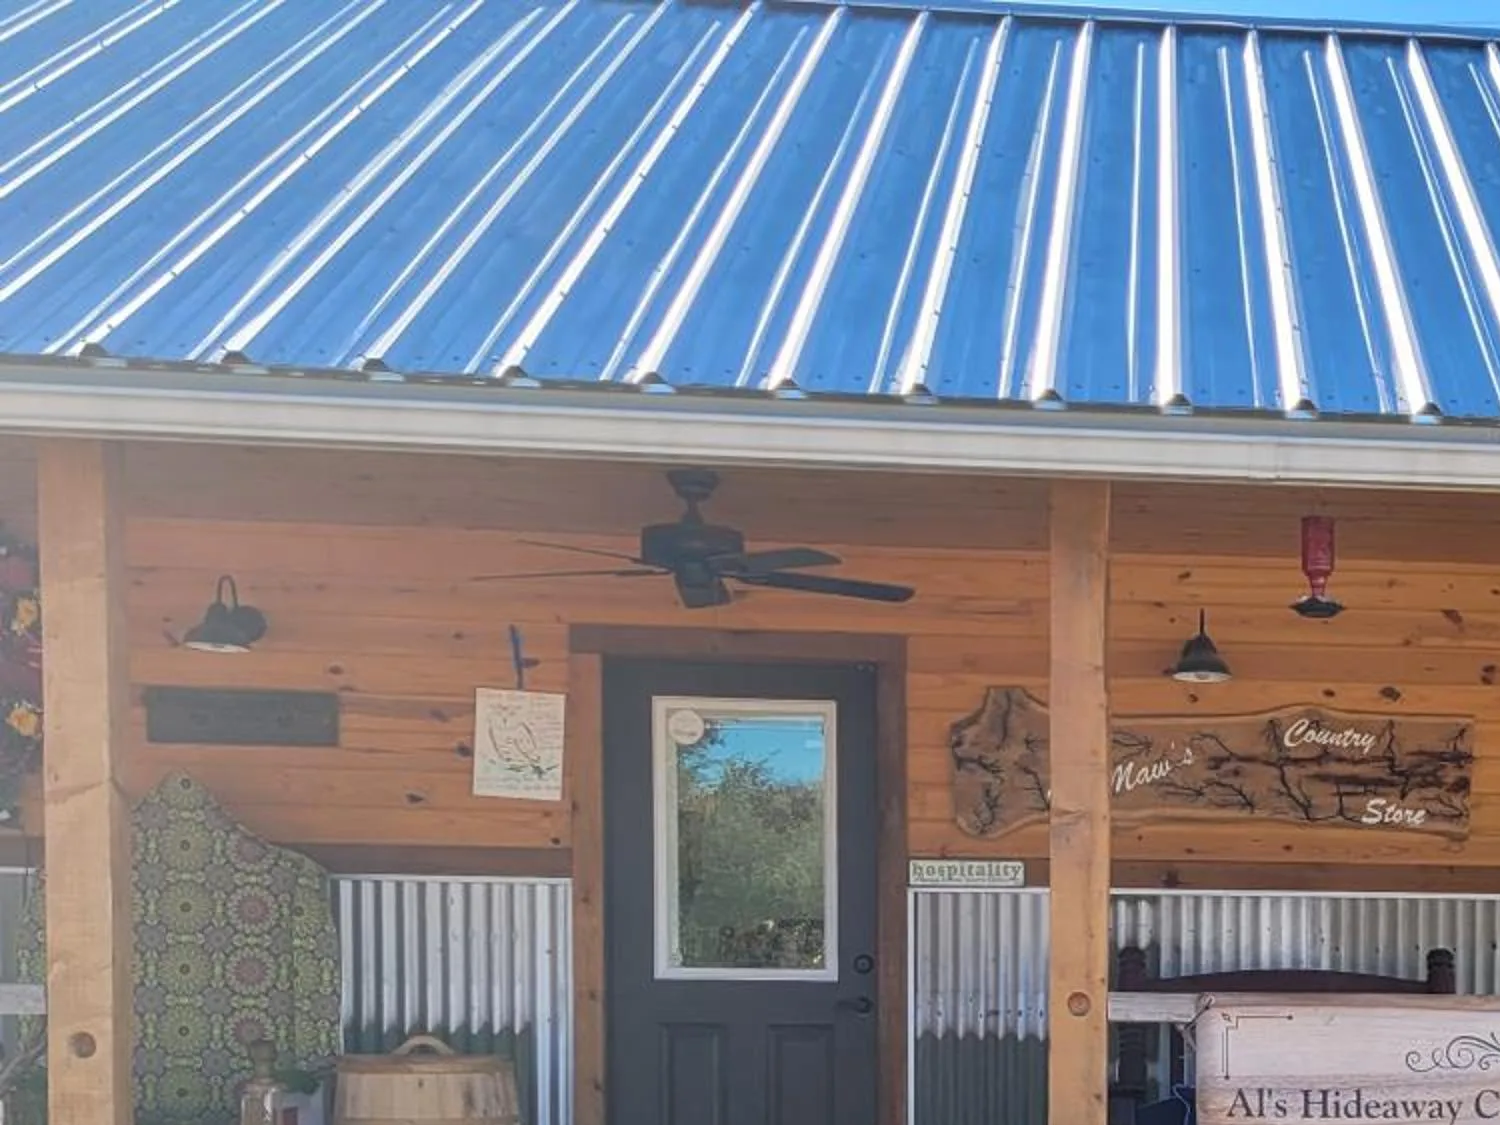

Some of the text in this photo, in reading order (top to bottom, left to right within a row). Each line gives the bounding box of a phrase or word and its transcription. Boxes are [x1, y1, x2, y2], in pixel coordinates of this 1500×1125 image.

[1284, 719, 1377, 754] Country
[1361, 798, 1426, 826] Store
[911, 863, 1022, 880] hospitality
[1226, 1088, 1287, 1118] Al's
[1301, 1089, 1463, 1125] Hideaway
